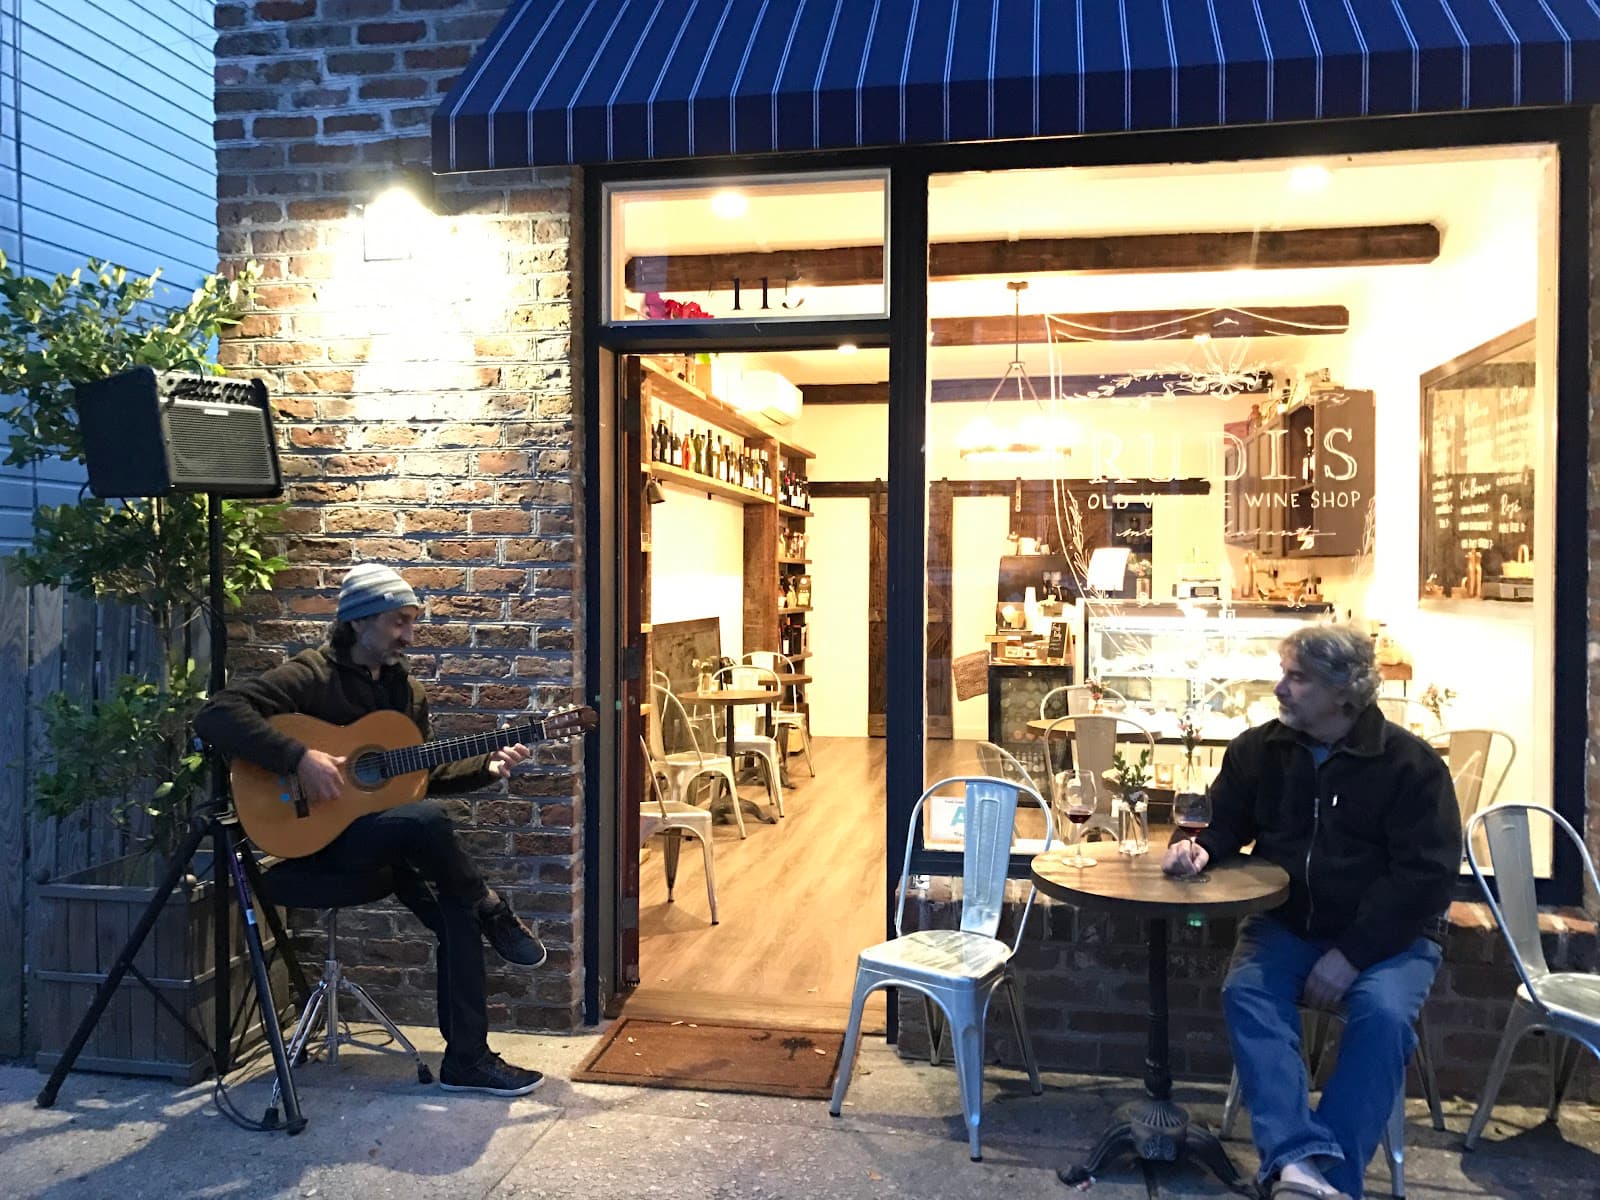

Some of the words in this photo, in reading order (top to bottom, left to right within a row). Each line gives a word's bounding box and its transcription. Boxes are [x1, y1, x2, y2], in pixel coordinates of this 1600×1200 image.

[1087, 492, 1129, 510] OLD
[1245, 492, 1300, 508] WINE
[1310, 490, 1361, 508] SHOP
